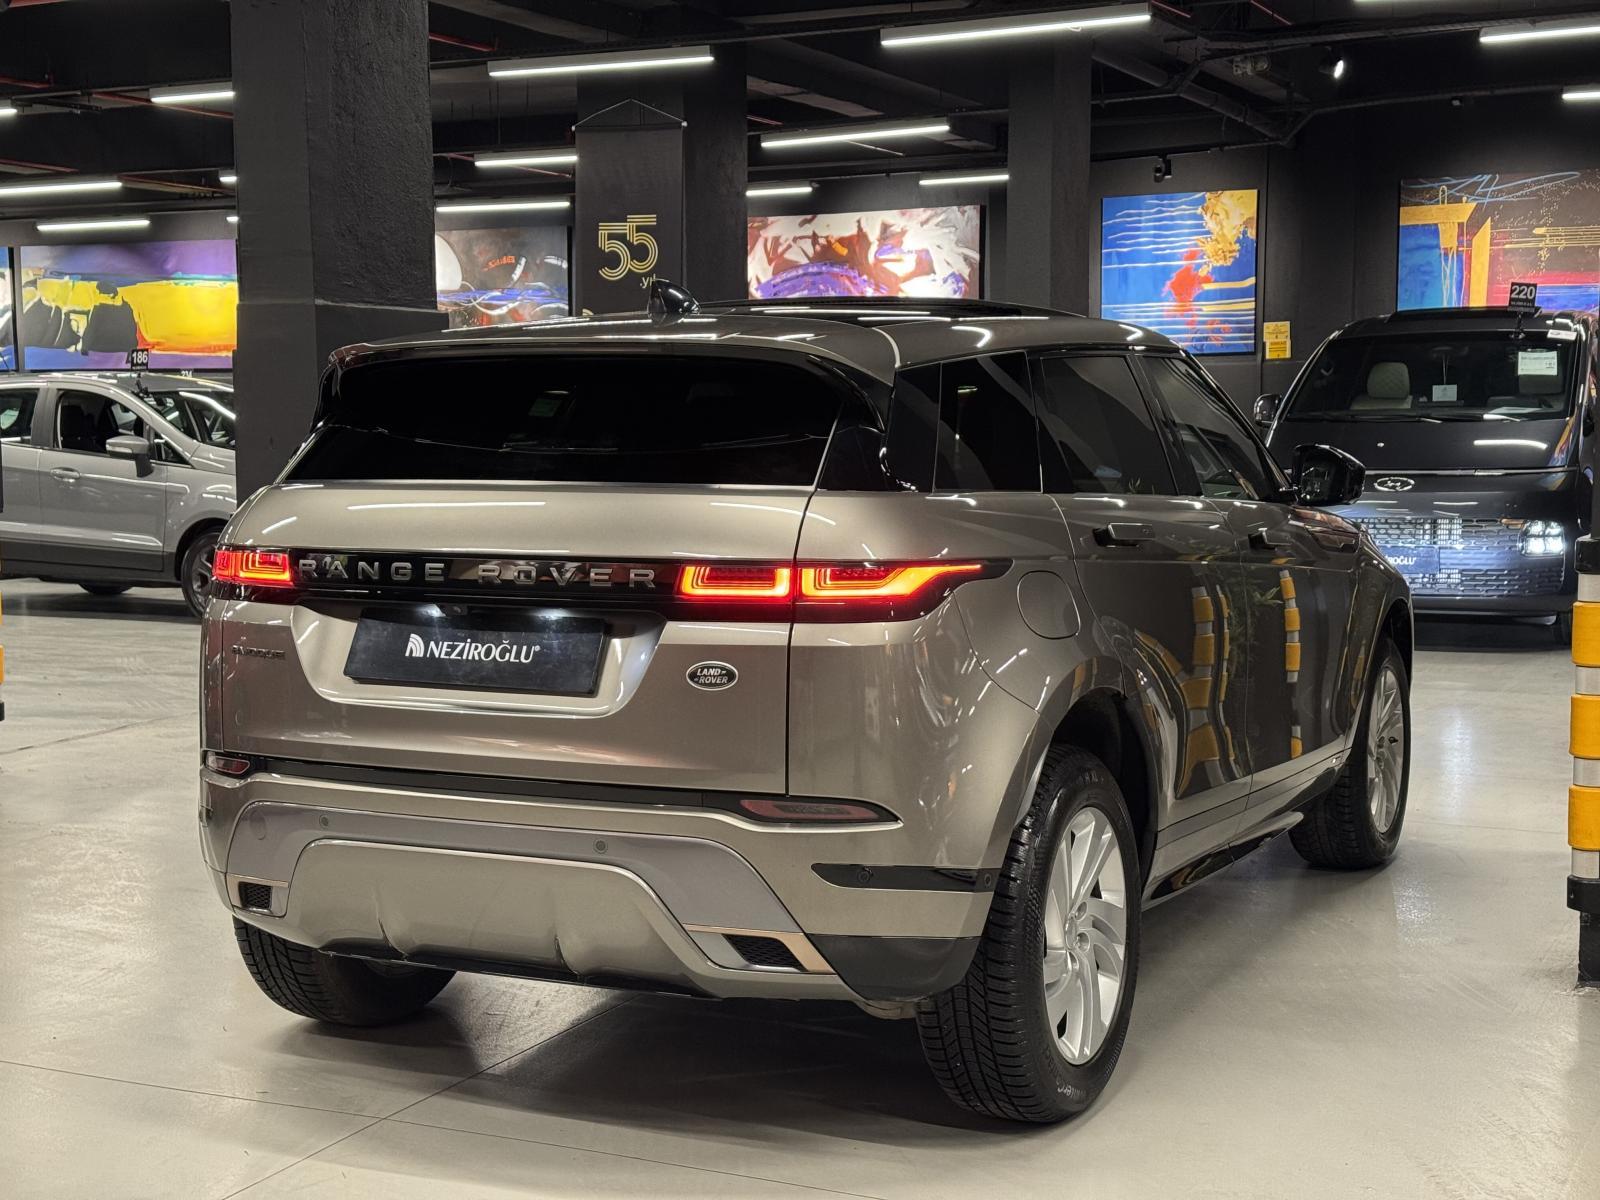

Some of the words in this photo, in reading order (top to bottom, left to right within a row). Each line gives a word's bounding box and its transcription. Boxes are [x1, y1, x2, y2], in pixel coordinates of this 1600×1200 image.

[598, 214, 658, 280] 55
[1510, 285, 1536, 299] 220
[132, 351, 148, 364] 186
[298, 559, 445, 582] RANGE
[477, 563, 656, 588] ROVER
[696, 668, 722, 676] LAND
[698, 676, 729, 684] ROVER
